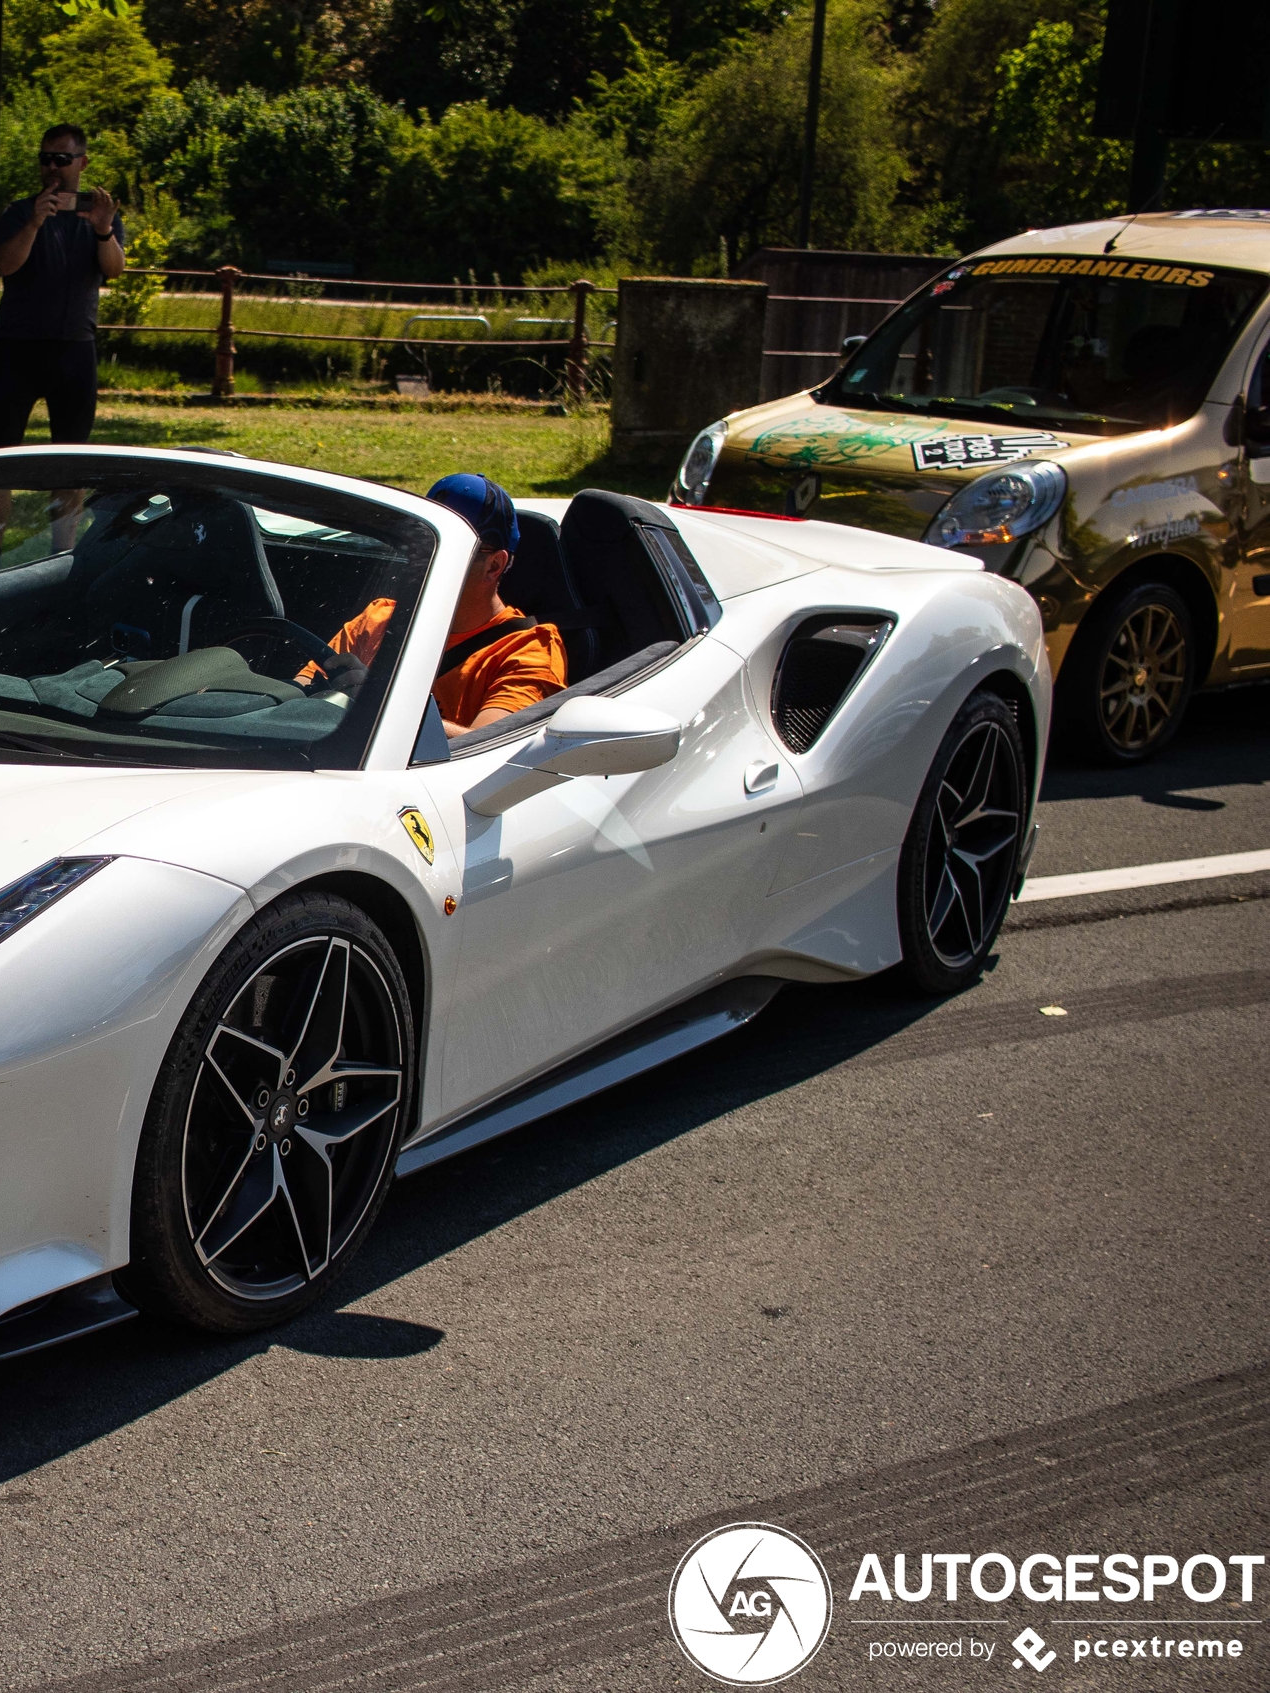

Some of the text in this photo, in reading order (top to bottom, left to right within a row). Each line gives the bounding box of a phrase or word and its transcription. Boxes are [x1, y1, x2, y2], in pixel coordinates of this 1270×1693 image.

[971, 259, 1215, 288] GUMBRANLEURS
[925, 447, 944, 457] 2
[943, 440, 968, 461] TOUR
